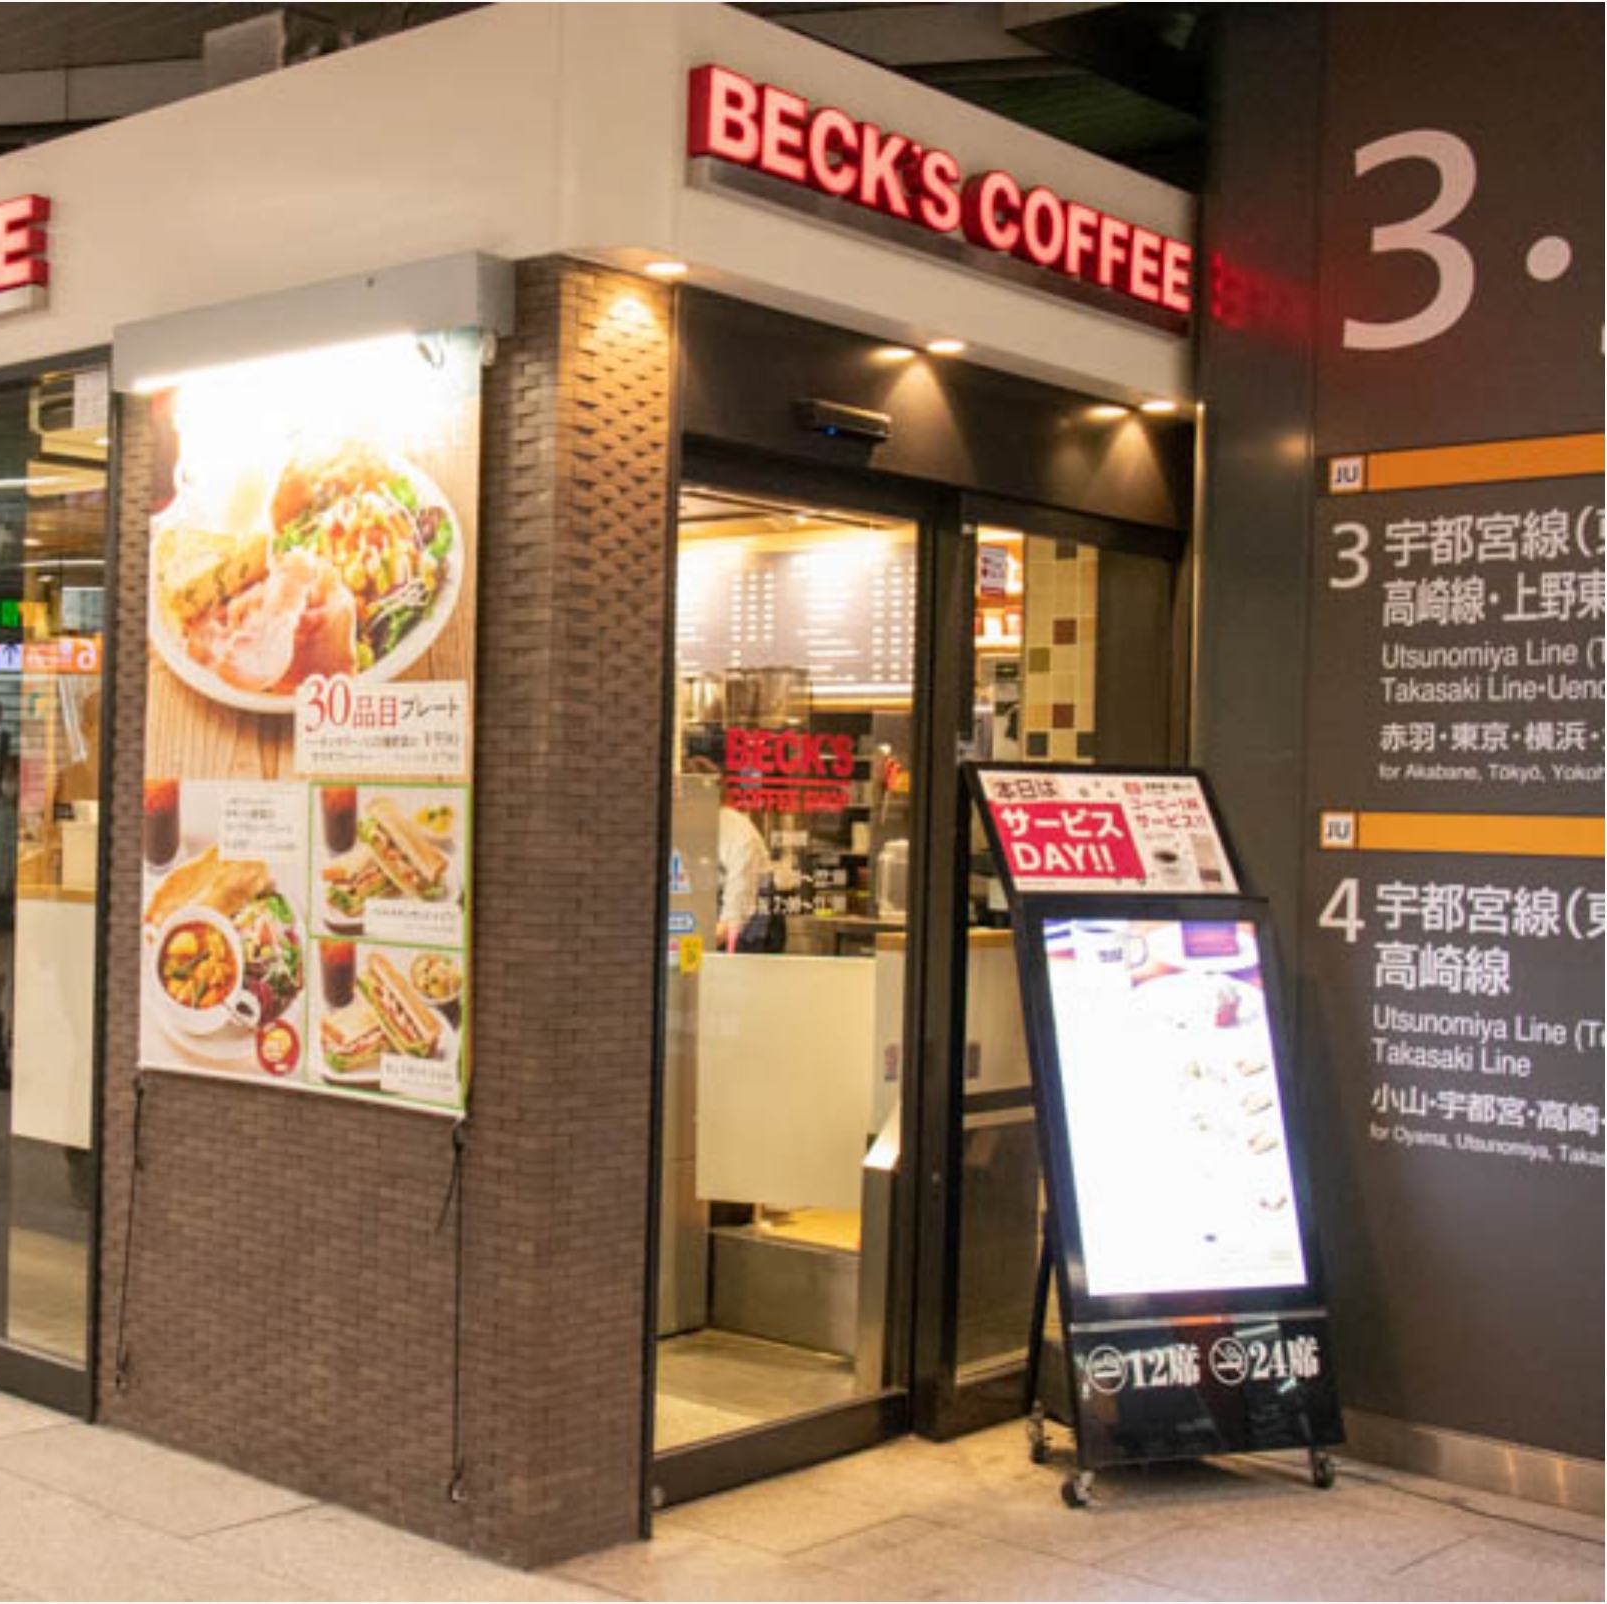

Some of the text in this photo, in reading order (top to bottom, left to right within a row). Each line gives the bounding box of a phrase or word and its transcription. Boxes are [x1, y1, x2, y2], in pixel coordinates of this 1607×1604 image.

[691, 64, 962, 233] BECK'S
[965, 169, 1192, 313] COFFEE
[1335, 464, 1359, 484] JU
[1329, 520, 1371, 588] 3
[1384, 506, 1605, 567] 宇都宮線(
[1382, 641, 1518, 672] Utsunomiya
[1526, 637, 1579, 666] Line
[1379, 674, 1481, 703] Takasaki
[725, 727, 854, 776] BECK'S
[1379, 721, 1605, 752] 赤羽・東京・横浜・
[1378, 763, 1401, 780] for
[1000, 806, 1124, 838] サービス
[1326, 819, 1351, 840] JU
[1011, 841, 1117, 873] DAY!!
[1317, 877, 1366, 943] 4
[1373, 940, 1512, 997] 高崎線
[1372, 1003, 1508, 1045] Utsunomiya
[1514, 1014, 1568, 1045] Line
[1371, 1037, 1532, 1078] Takasaki Line
[1369, 1122, 1390, 1141] for
